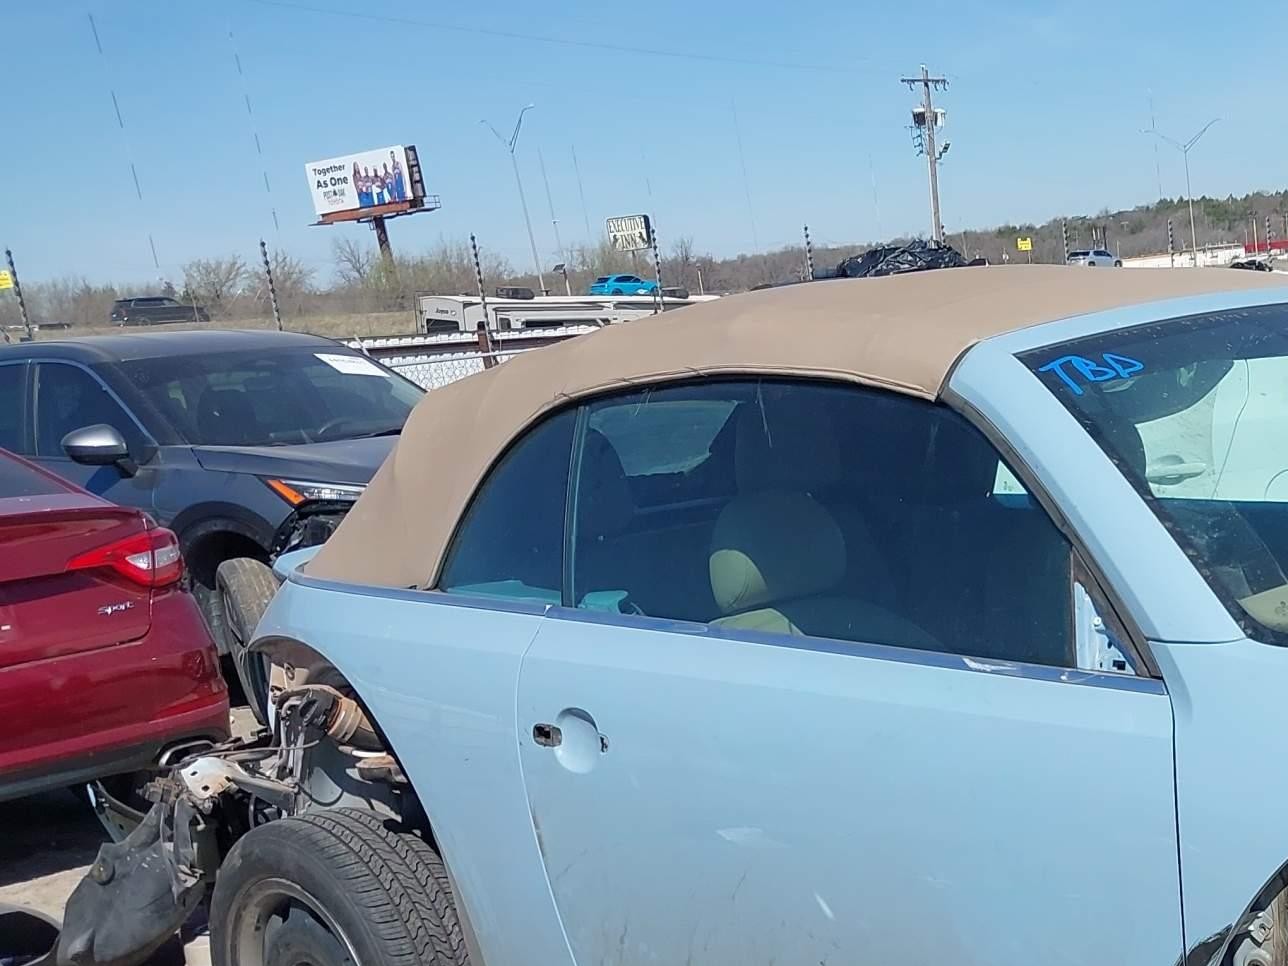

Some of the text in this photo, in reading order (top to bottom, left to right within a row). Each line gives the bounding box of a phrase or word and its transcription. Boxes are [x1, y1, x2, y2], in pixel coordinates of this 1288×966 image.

[312, 164, 345, 176] Together
[316, 175, 349, 190] As One
[608, 217, 644, 233] EXECUTIVE
[620, 233, 638, 249] INN
